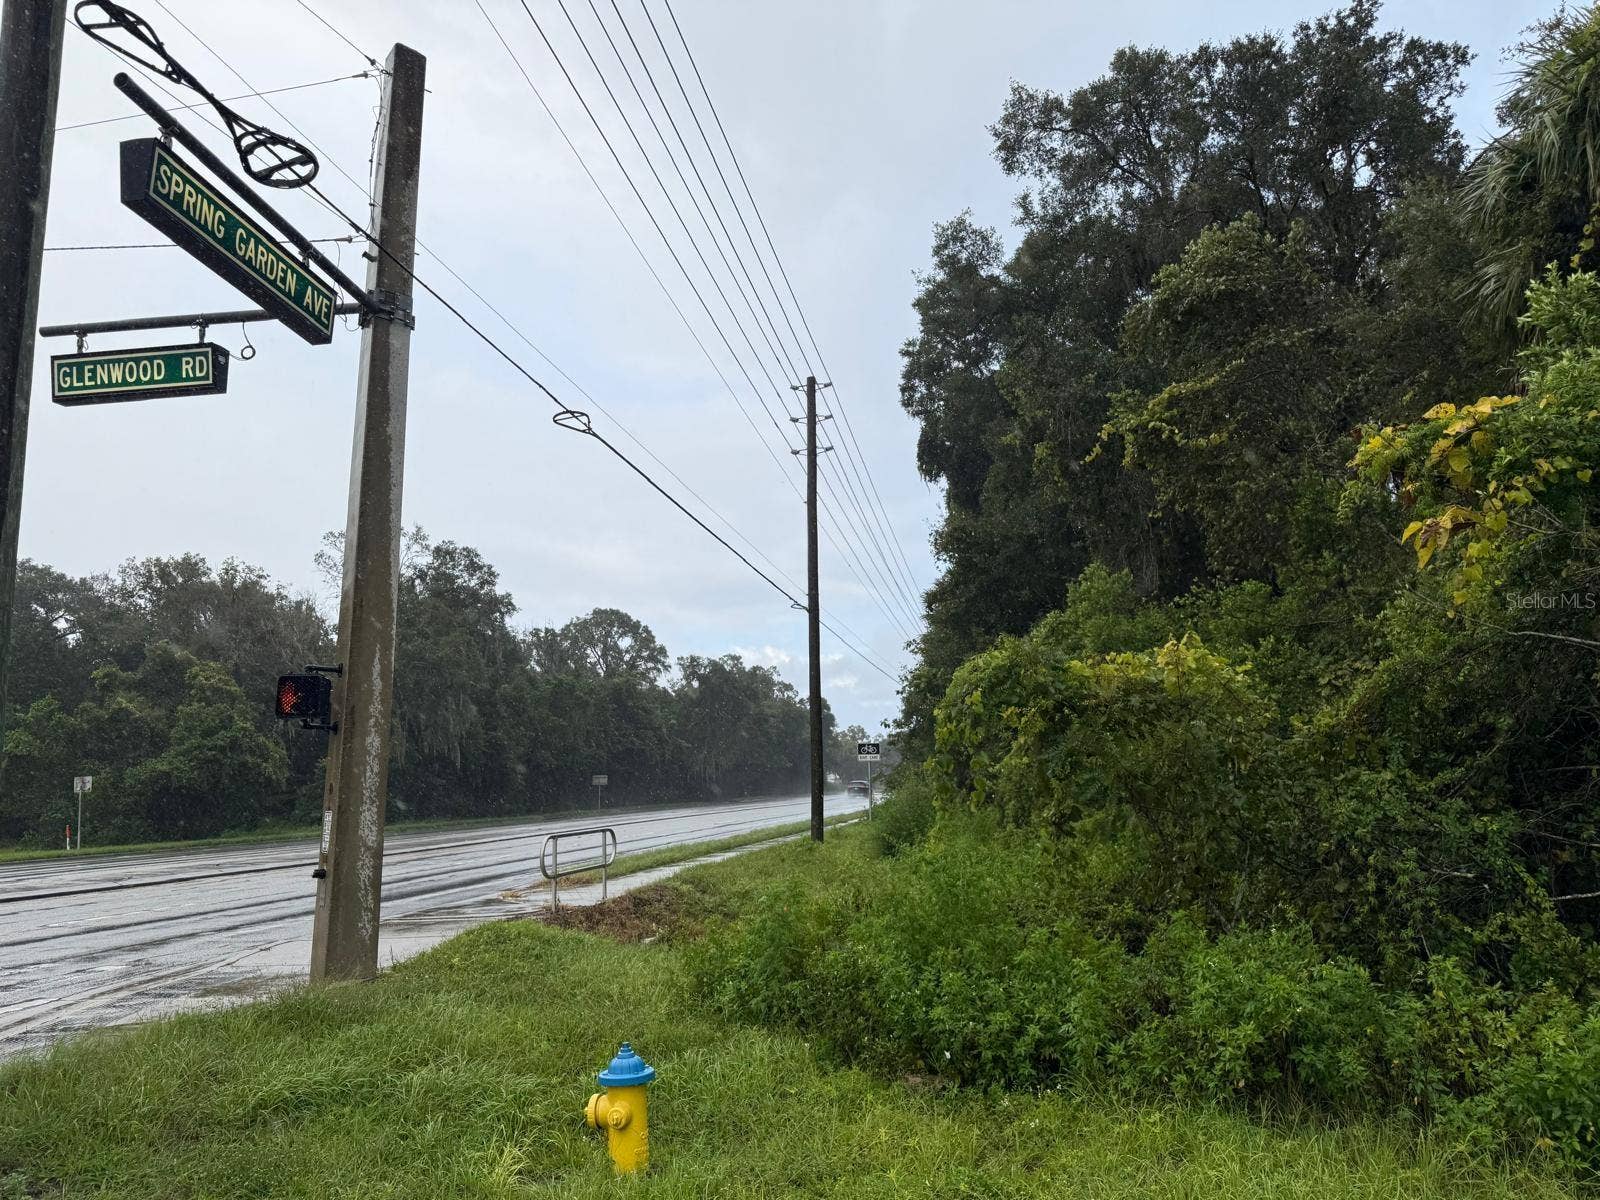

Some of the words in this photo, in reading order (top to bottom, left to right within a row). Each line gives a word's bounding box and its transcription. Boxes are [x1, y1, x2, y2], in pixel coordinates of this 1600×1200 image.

[157, 164, 227, 239] SPRING
[235, 228, 297, 298] GARDEN
[303, 286, 331, 325] AVE
[59, 359, 166, 389] GLENWOOD
[181, 355, 208, 379] RD
